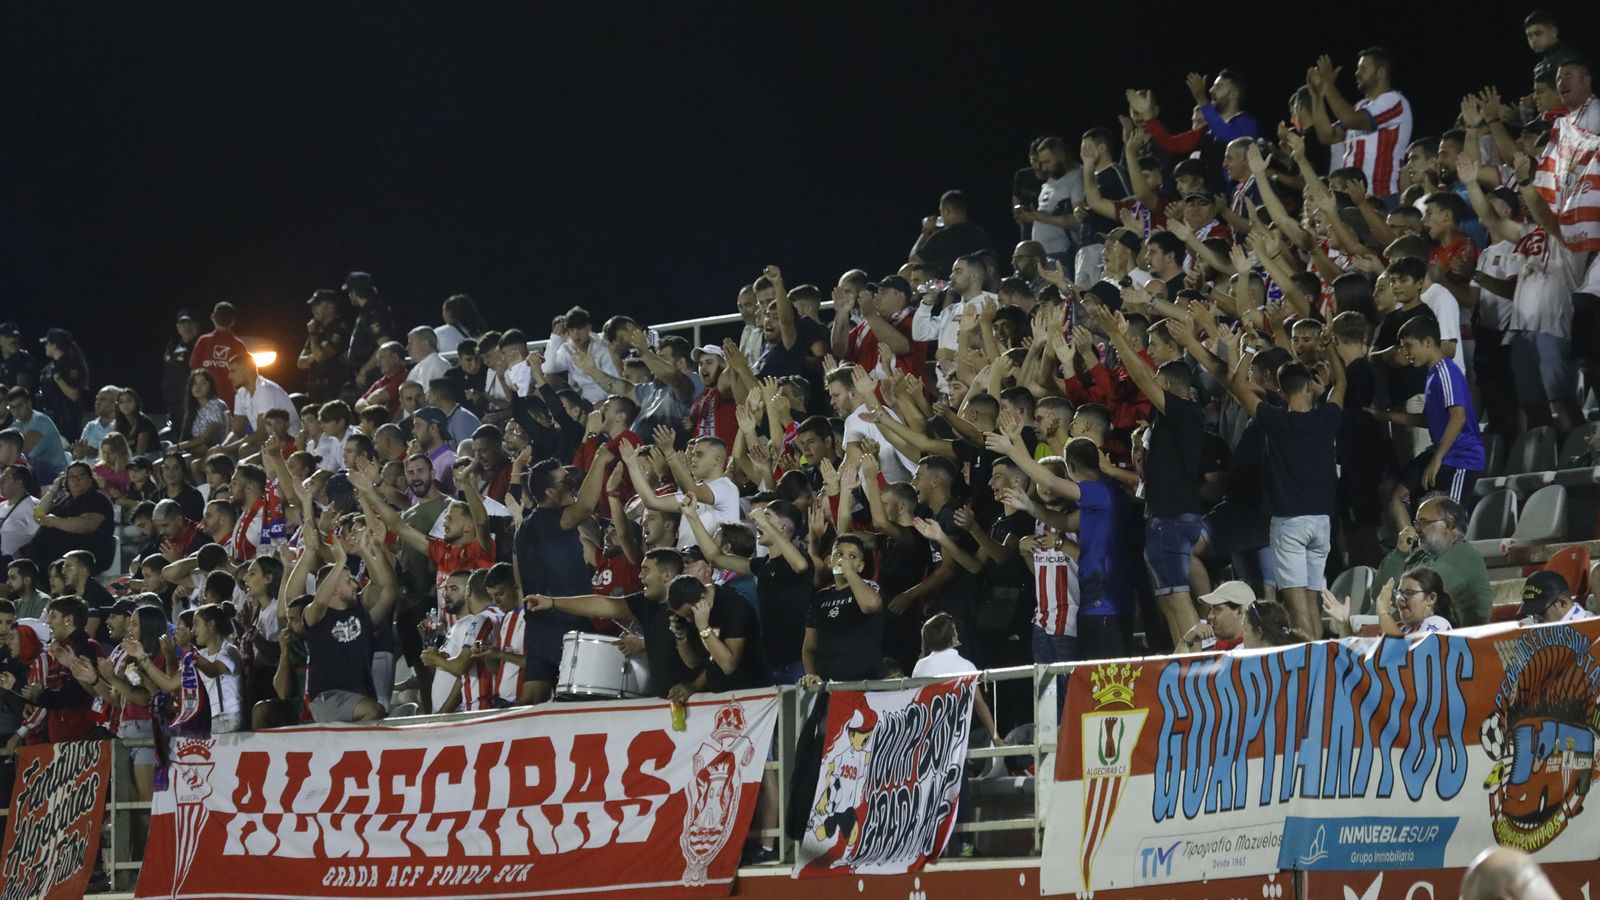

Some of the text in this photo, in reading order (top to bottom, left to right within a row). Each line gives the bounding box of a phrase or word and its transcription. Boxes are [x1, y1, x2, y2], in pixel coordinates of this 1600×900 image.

[840, 765, 857, 780] 1909
[222, 728, 678, 858] ALGECIRAS
[1234, 831, 1284, 851] Mazuelos
[1339, 825, 1440, 844] INMUEBLESUR
[1212, 858, 1230, 869] Desde
[1350, 851, 1373, 866] Grupo
[322, 865, 378, 888] GRADA
[386, 865, 424, 887] ACF
[426, 864, 492, 886] FONDO
